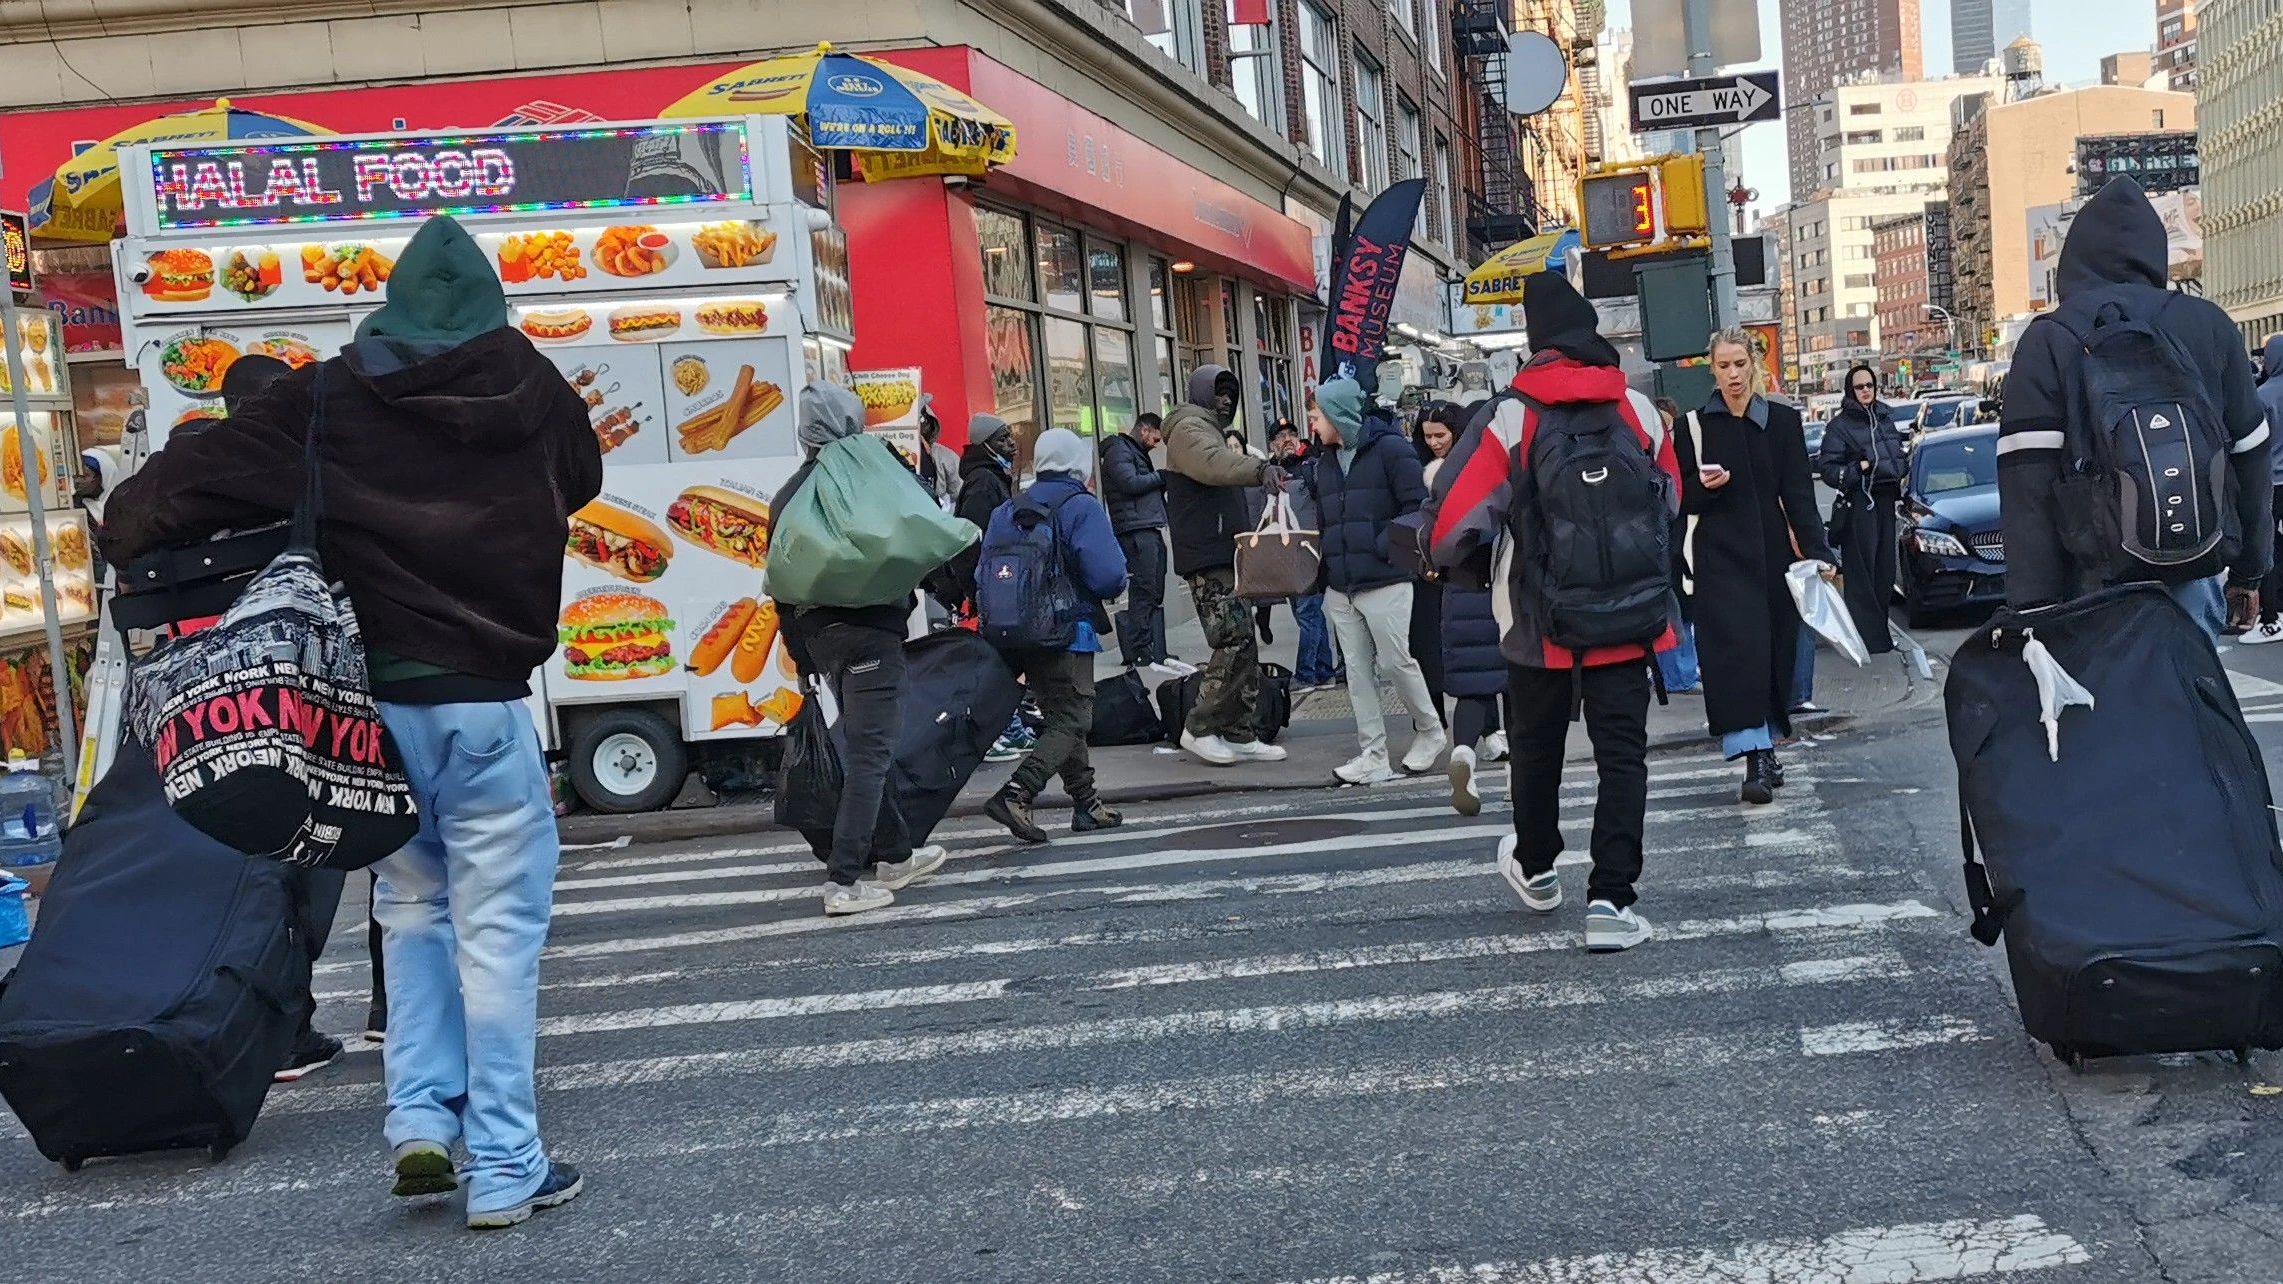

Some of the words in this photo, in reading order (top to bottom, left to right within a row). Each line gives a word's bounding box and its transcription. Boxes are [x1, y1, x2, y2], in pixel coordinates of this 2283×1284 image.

[1651, 95, 1693, 117] ONE
[1713, 88, 1756, 111] WAY
[157, 157, 342, 211] HALAL
[353, 148, 514, 202] FOOD
[1632, 186, 1653, 232] 3
[1332, 236, 1383, 353] BANKSY
[1360, 242, 1403, 359] MUSEUM
[1469, 276, 1521, 296] SABRE
[161, 692, 184, 715] NEW
[186, 676, 221, 699] YORK
[181, 687, 274, 742] YOK
[327, 785, 372, 812] YORK
